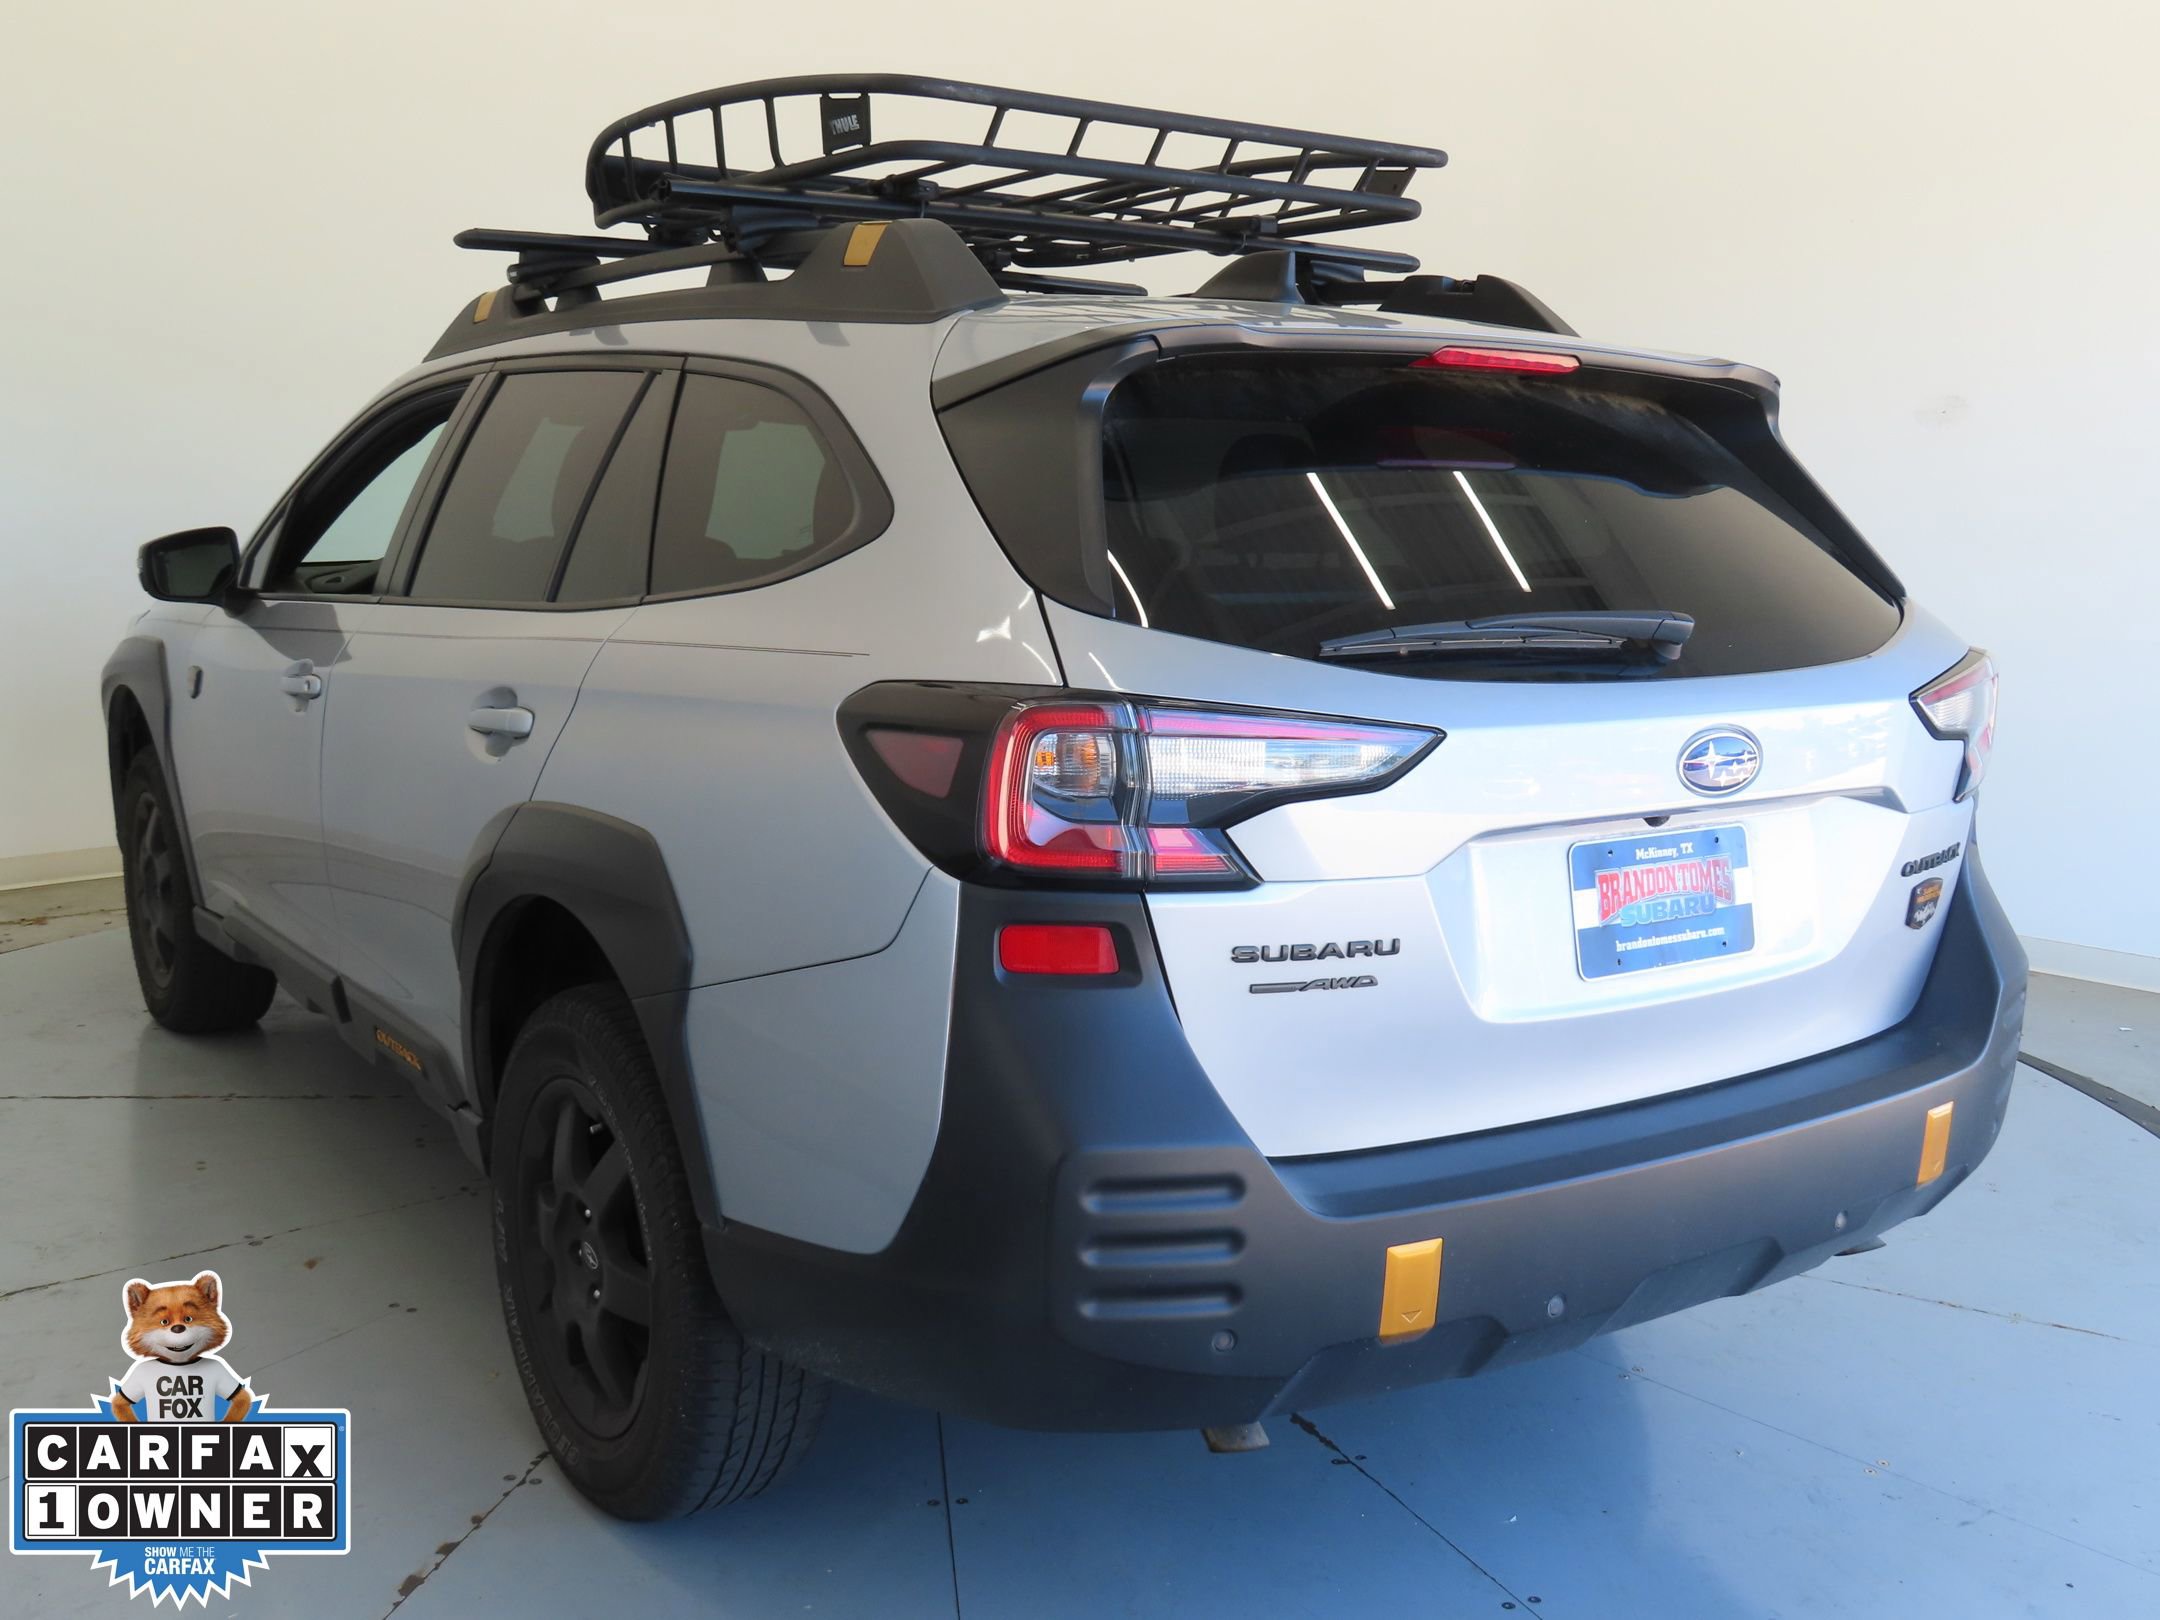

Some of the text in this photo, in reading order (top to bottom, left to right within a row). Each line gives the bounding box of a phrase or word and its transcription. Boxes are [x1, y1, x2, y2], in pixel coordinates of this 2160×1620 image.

[831, 114, 860, 135] THULE
[1636, 842, 1694, 860] McKinney, TX
[1901, 841, 1960, 877] OUTBACK
[1596, 865, 1680, 922] BRANDON
[1619, 893, 1717, 927] SUBARU
[1231, 938, 1400, 963] SUBARU
[1298, 975, 1378, 992] AWD
